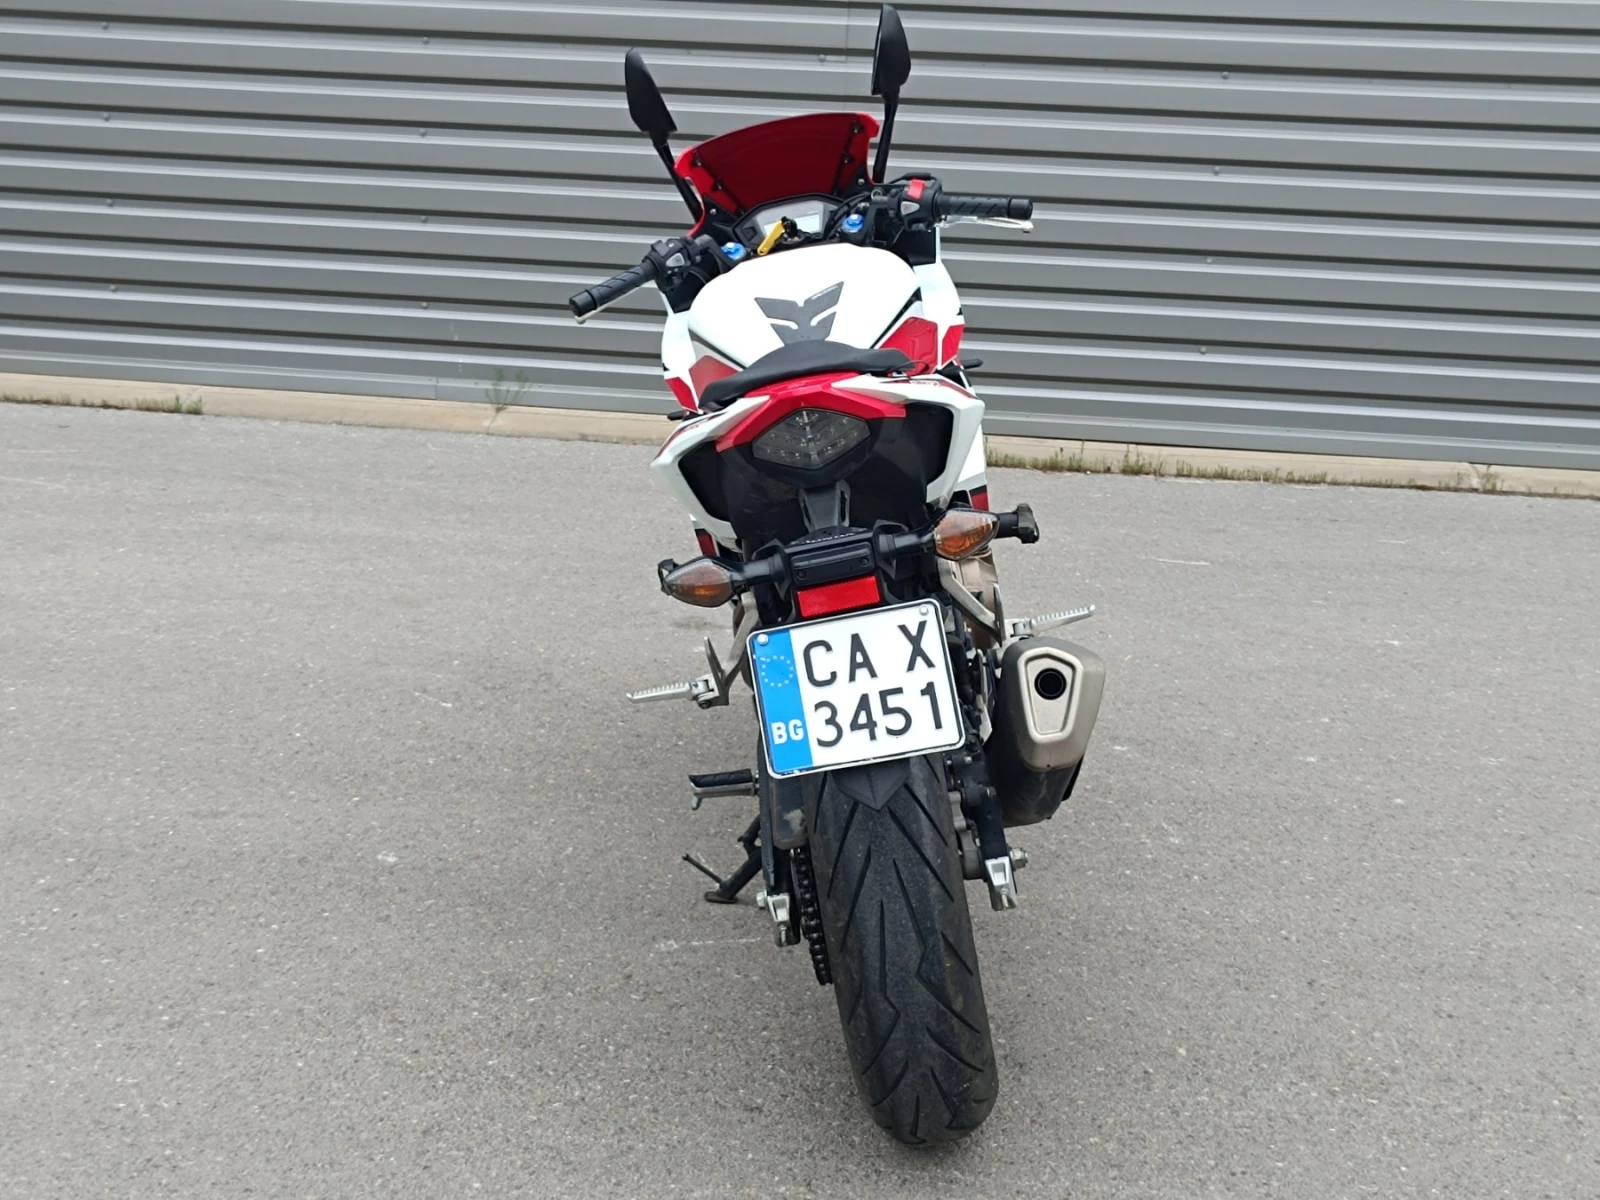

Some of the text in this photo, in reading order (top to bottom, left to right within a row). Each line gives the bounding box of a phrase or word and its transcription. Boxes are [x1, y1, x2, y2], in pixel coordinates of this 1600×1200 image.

[803, 620, 936, 687] CA X
[771, 719, 805, 745] BG
[814, 681, 943, 747] 3451
